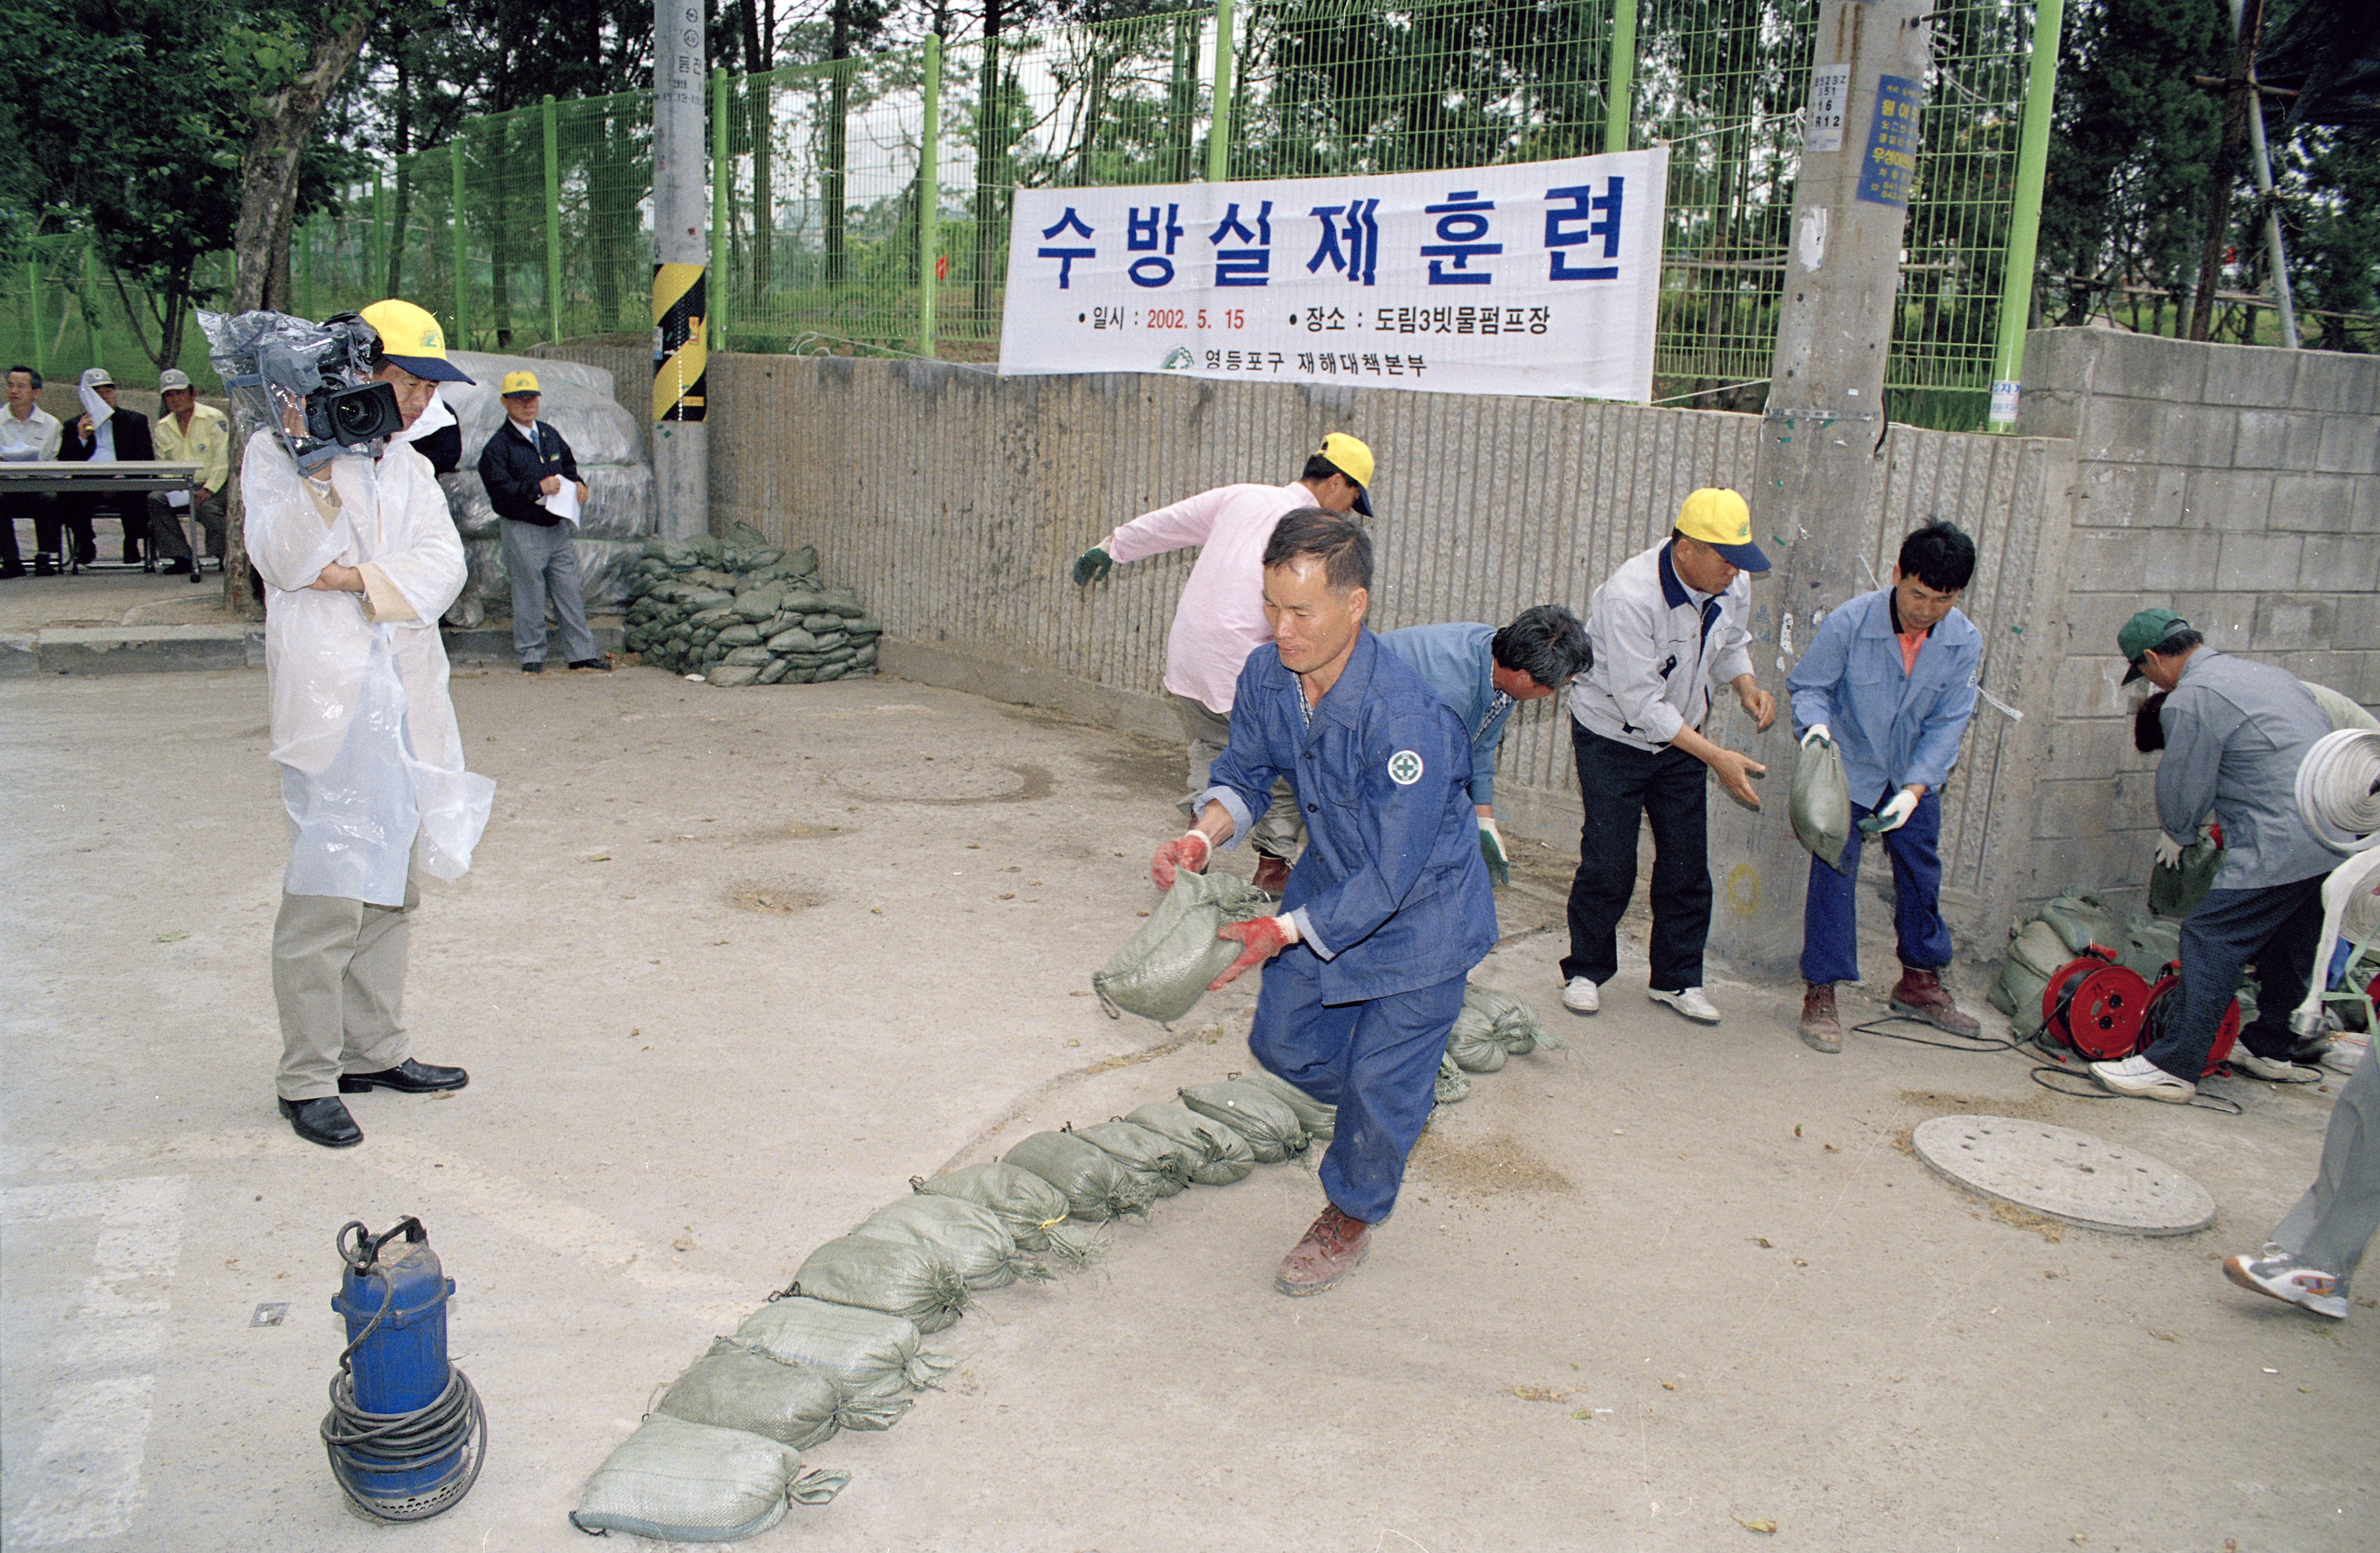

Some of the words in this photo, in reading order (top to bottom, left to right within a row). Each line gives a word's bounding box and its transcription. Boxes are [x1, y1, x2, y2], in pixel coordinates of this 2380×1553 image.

[1819, 99, 1832, 111] 16
[1225, 309, 1244, 329] 15
[1375, 306, 1550, 335] 도림3빗물펌프장
[1206, 349, 1285, 373] 영등포구
[1297, 352, 1427, 378] 재해대책본부
